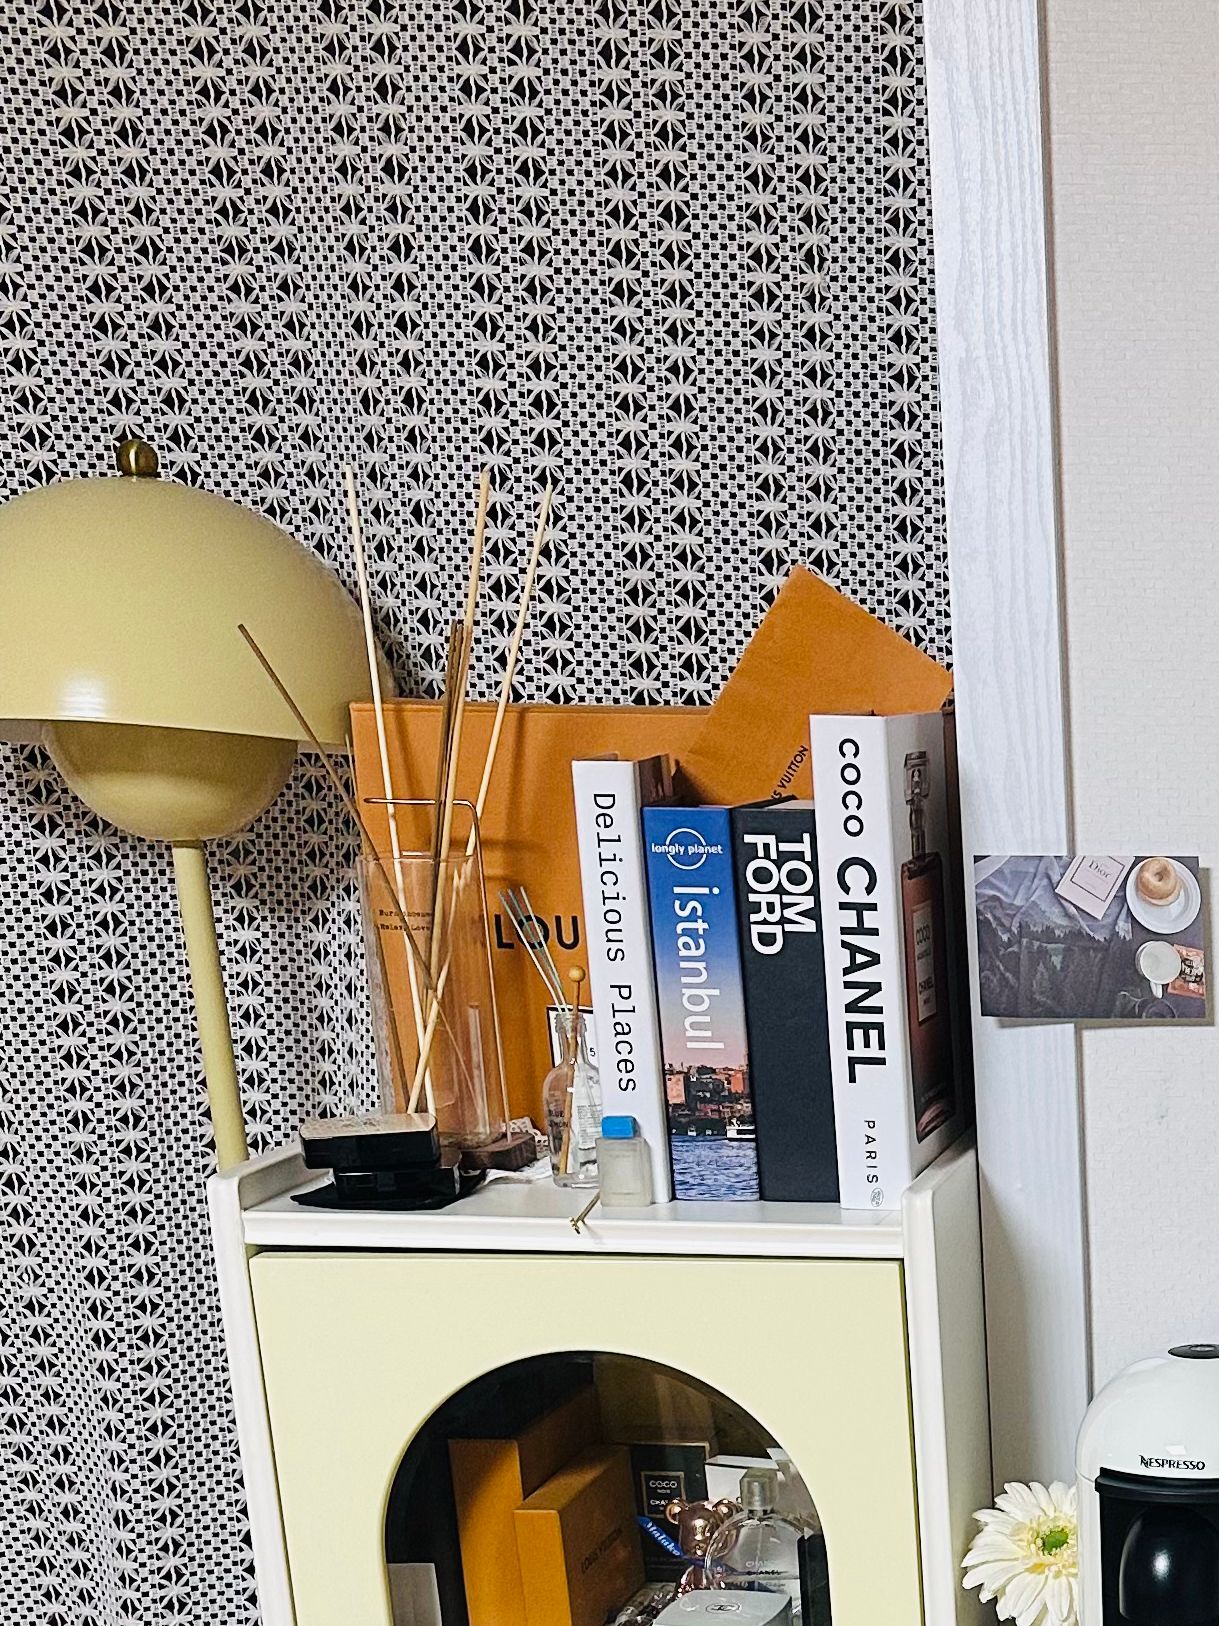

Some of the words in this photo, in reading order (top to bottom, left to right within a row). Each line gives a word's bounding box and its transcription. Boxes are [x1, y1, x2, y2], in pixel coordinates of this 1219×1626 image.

[777, 745, 809, 789] VUITTON
[838, 738, 864, 838] COCO
[593, 793, 627, 963] Delicious
[688, 843, 724, 856] planet
[778, 833, 817, 933] TOM
[1088, 859, 1112, 880] Dior
[743, 834, 784, 955] FORD
[836, 856, 887, 1084] CHANEL
[609, 984, 637, 1092] Places
[863, 1119, 879, 1184] PARIS
[649, 1480, 678, 1488] COCO
[1138, 1454, 1206, 1471] NESPRESSO
